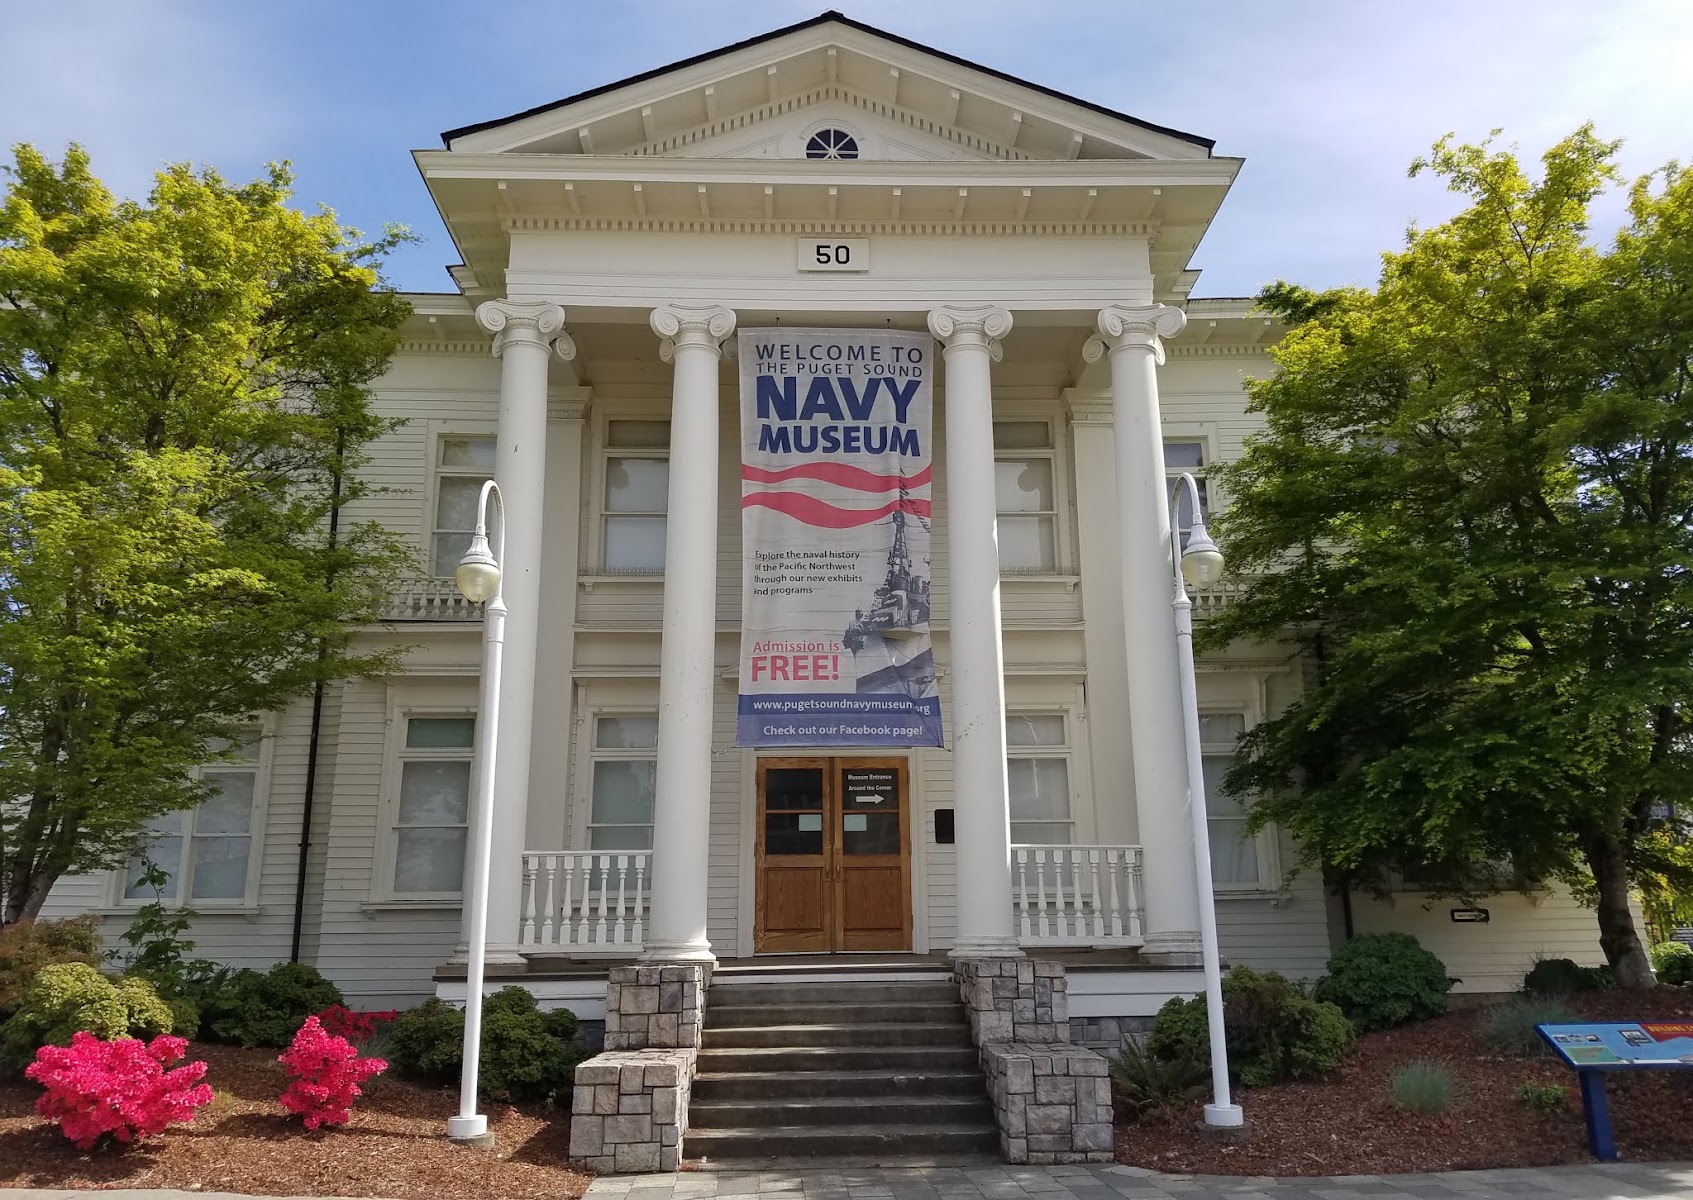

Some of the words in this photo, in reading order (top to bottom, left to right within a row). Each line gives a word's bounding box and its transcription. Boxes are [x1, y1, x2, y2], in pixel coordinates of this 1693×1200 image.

[816, 245, 850, 265] 50
[755, 344, 881, 362] WELCOME
[892, 346, 923, 364] TO
[755, 362, 788, 375] THE
[797, 363, 855, 375] PUGET
[863, 363, 923, 378] SOUND
[756, 375, 922, 424] NAVY
[758, 423, 921, 457] MUSEUM
[755, 550, 785, 562] Explore
[786, 550, 802, 559] the
[803, 550, 827, 559] naval
[829, 550, 860, 561] history
[754, 562, 762, 571] of
[762, 563, 778, 572] the
[779, 561, 807, 571] Pacific
[809, 561, 856, 571] Northwest
[754, 574, 787, 585] through
[827, 573, 863, 583] exhibits
[753, 587, 769, 596] and
[770, 587, 814, 597] programs
[752, 640, 825, 653] Admission
[829, 640, 840, 652] is
[751, 654, 840, 682] FREE!
[753, 699, 931, 716] www.pugetsoundnavymuseumorg
[763, 725, 797, 736] Check
[798, 726, 817, 735] out
[818, 726, 838, 735] our
[839, 725, 892, 735] Facebook
[892, 725, 923, 738] page!
[869, 773, 893, 781] Entrance
